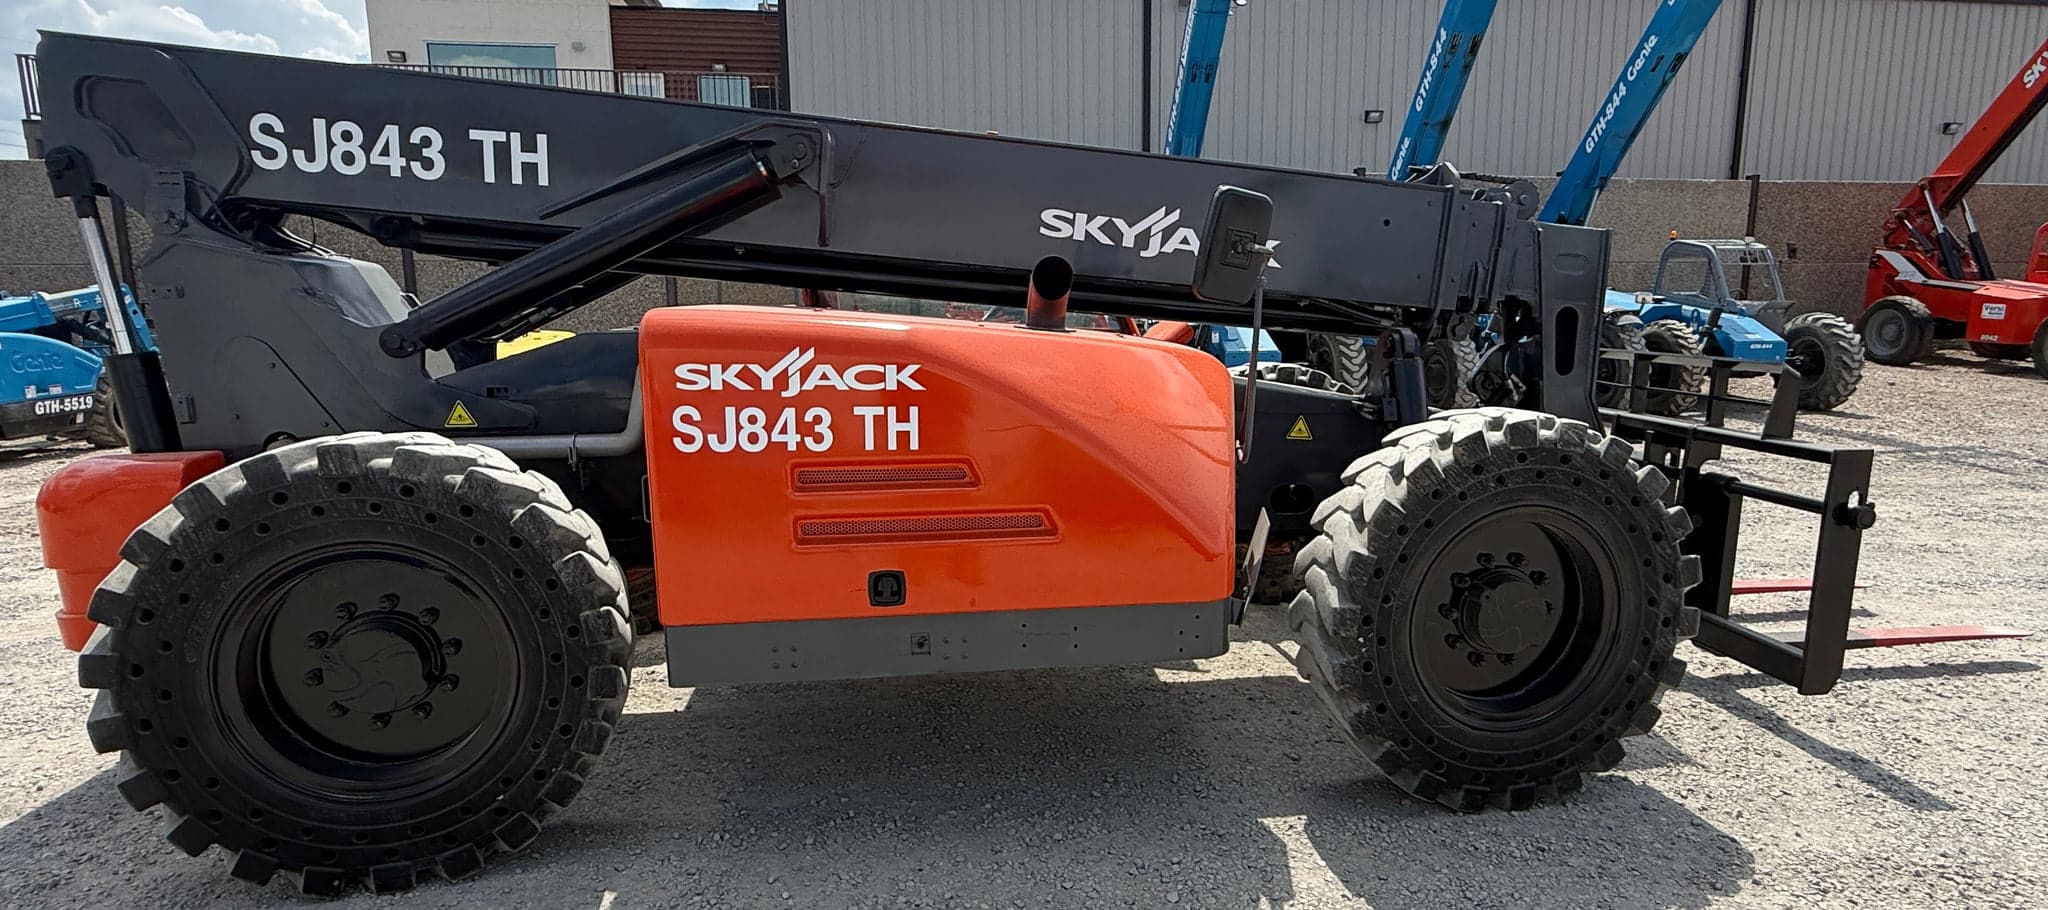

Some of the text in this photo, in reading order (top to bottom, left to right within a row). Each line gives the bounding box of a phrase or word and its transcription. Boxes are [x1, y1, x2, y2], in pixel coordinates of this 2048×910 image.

[1415, 27, 1447, 112] GTH-844
[1585, 34, 1659, 154] GTH-844 Genie
[249, 112, 549, 187] SJ843 TH
[1391, 136, 1411, 182] Genie
[674, 346, 927, 398] SKYJACK
[34, 396, 94, 415] GTH-5519
[672, 405, 920, 453] SJ843 TH
